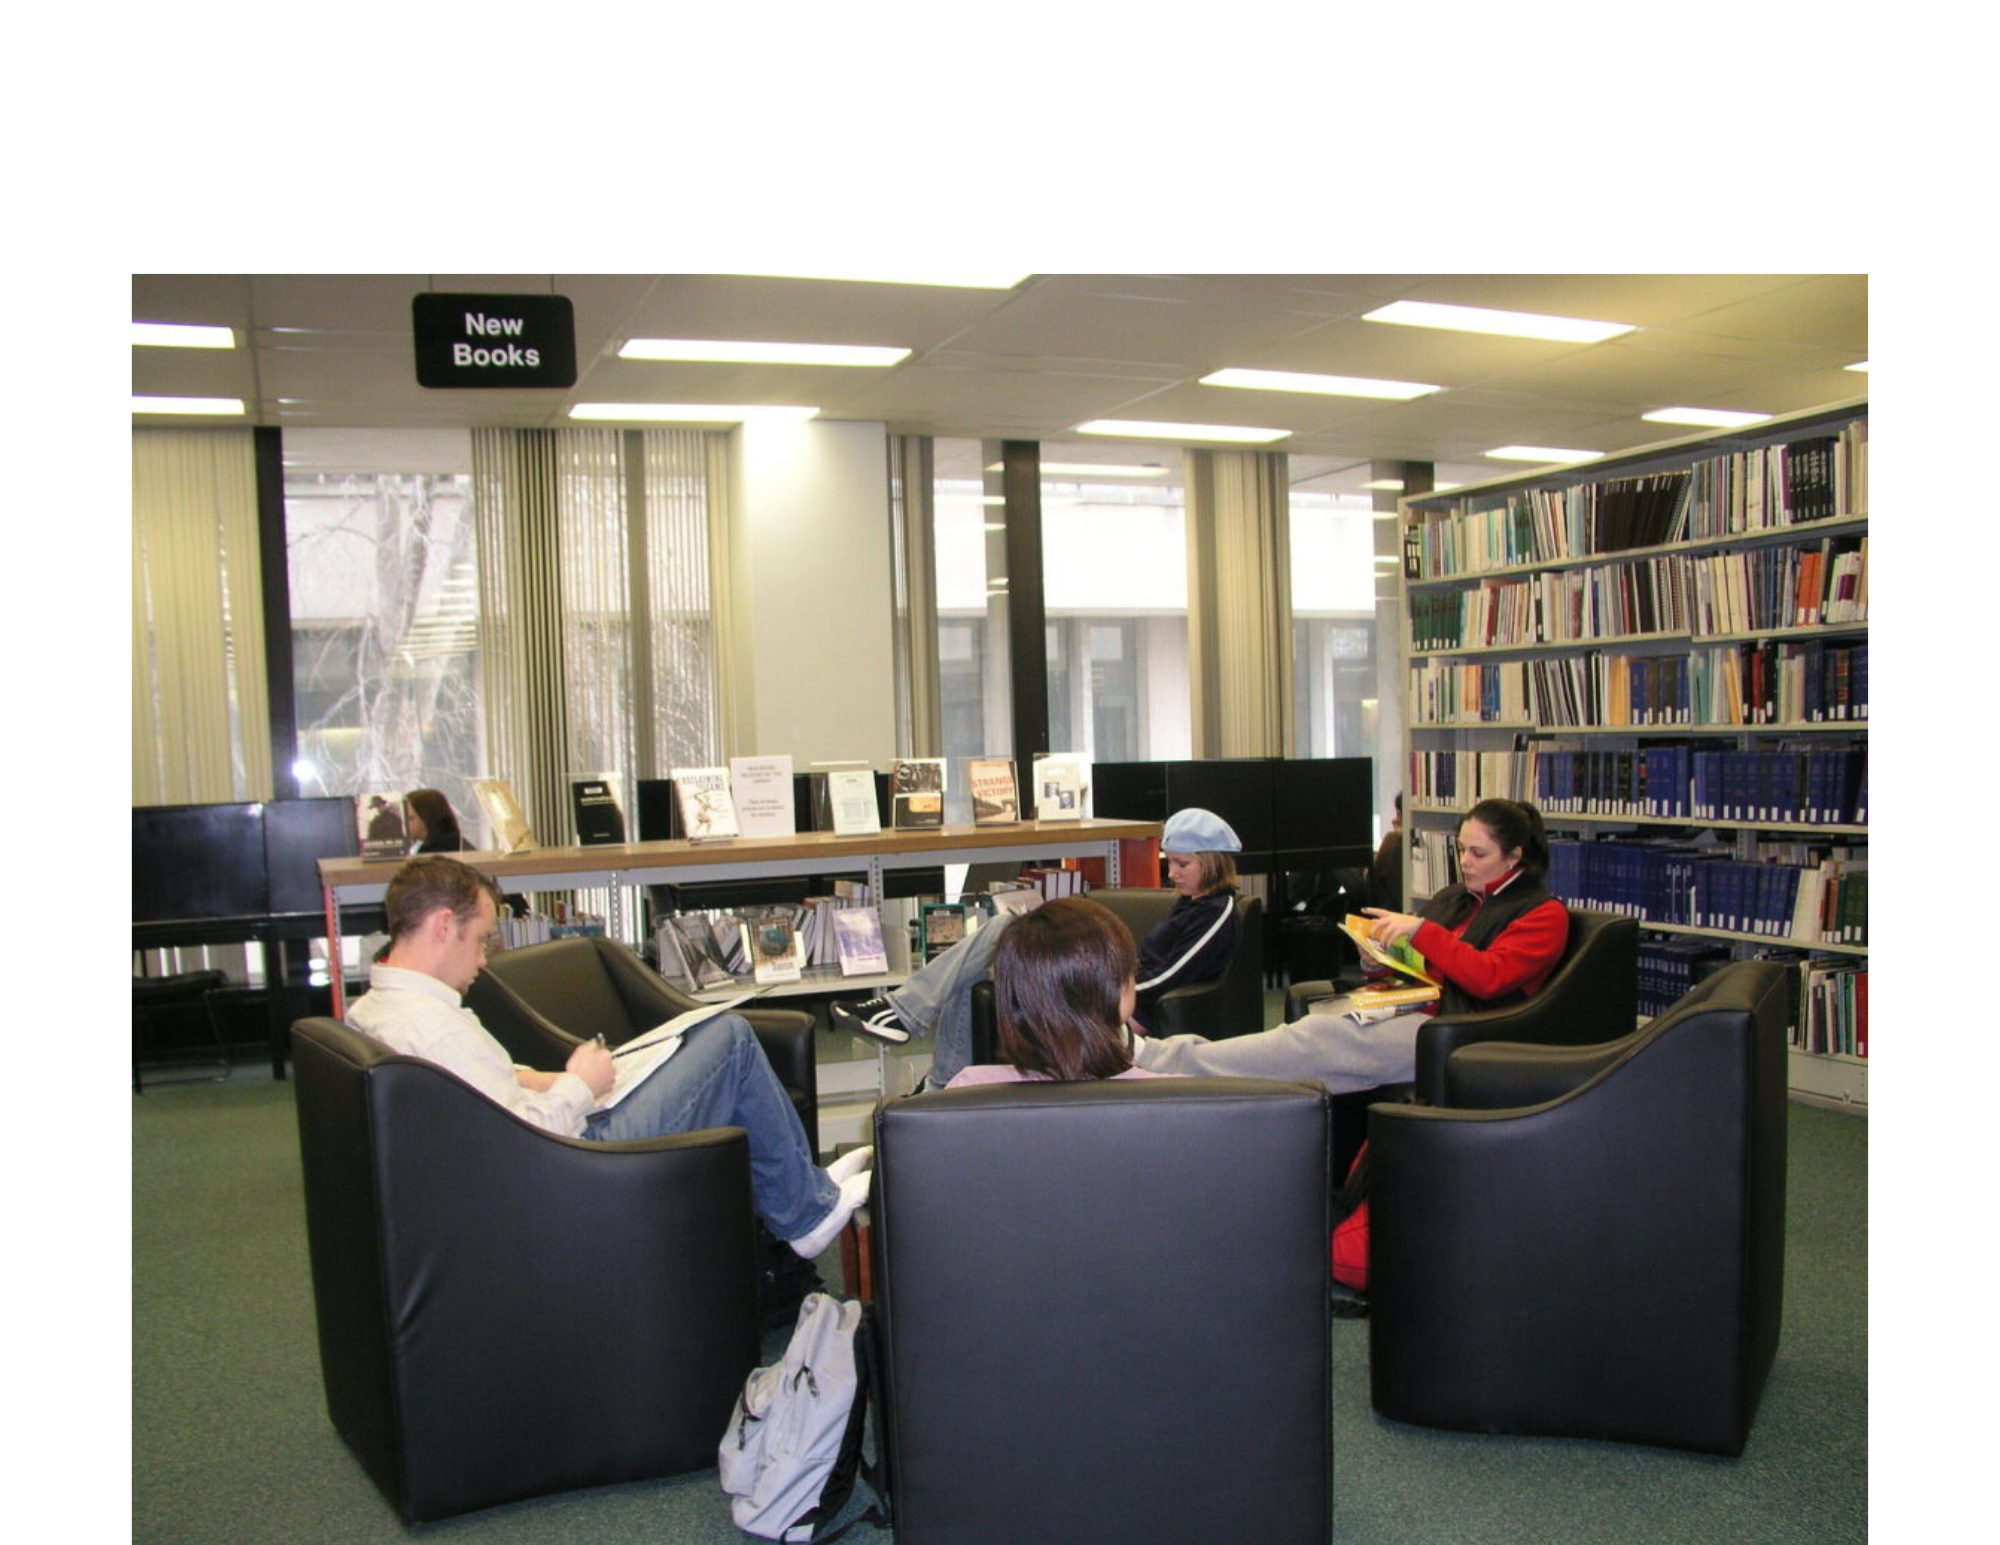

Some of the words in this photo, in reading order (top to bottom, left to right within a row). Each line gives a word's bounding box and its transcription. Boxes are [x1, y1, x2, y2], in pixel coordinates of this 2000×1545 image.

[465, 312, 524, 336] New
[453, 343, 540, 366] Books
[976, 787, 1013, 798] VICTORY
